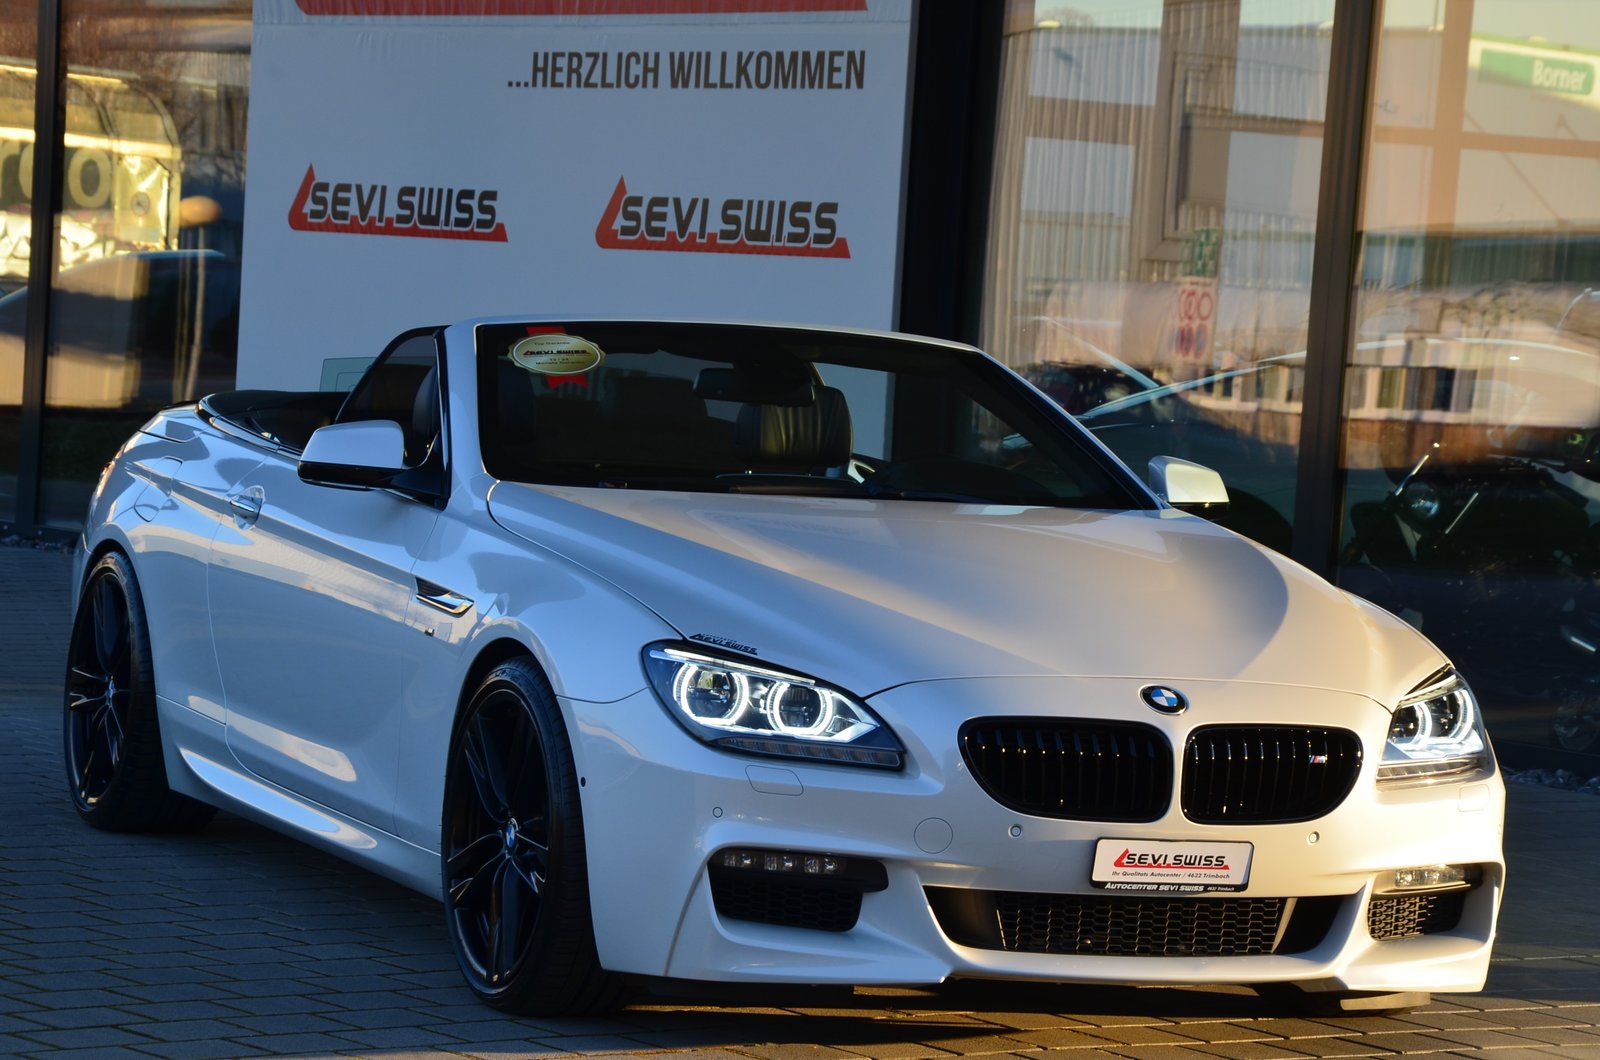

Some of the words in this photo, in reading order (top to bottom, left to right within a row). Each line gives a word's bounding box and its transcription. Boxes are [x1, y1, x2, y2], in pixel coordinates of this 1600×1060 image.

[507, 51, 660, 89] ...HERZLICH
[669, 50, 866, 90] WILLKOMMEN
[1532, 59, 1587, 92] Borner
[308, 181, 388, 224] SEVI
[394, 186, 498, 230] SWISS
[619, 195, 710, 241] SEVI
[718, 198, 839, 245] SWISS
[1125, 853, 1168, 866] SEVI
[1172, 854, 1226, 867] SWISS
